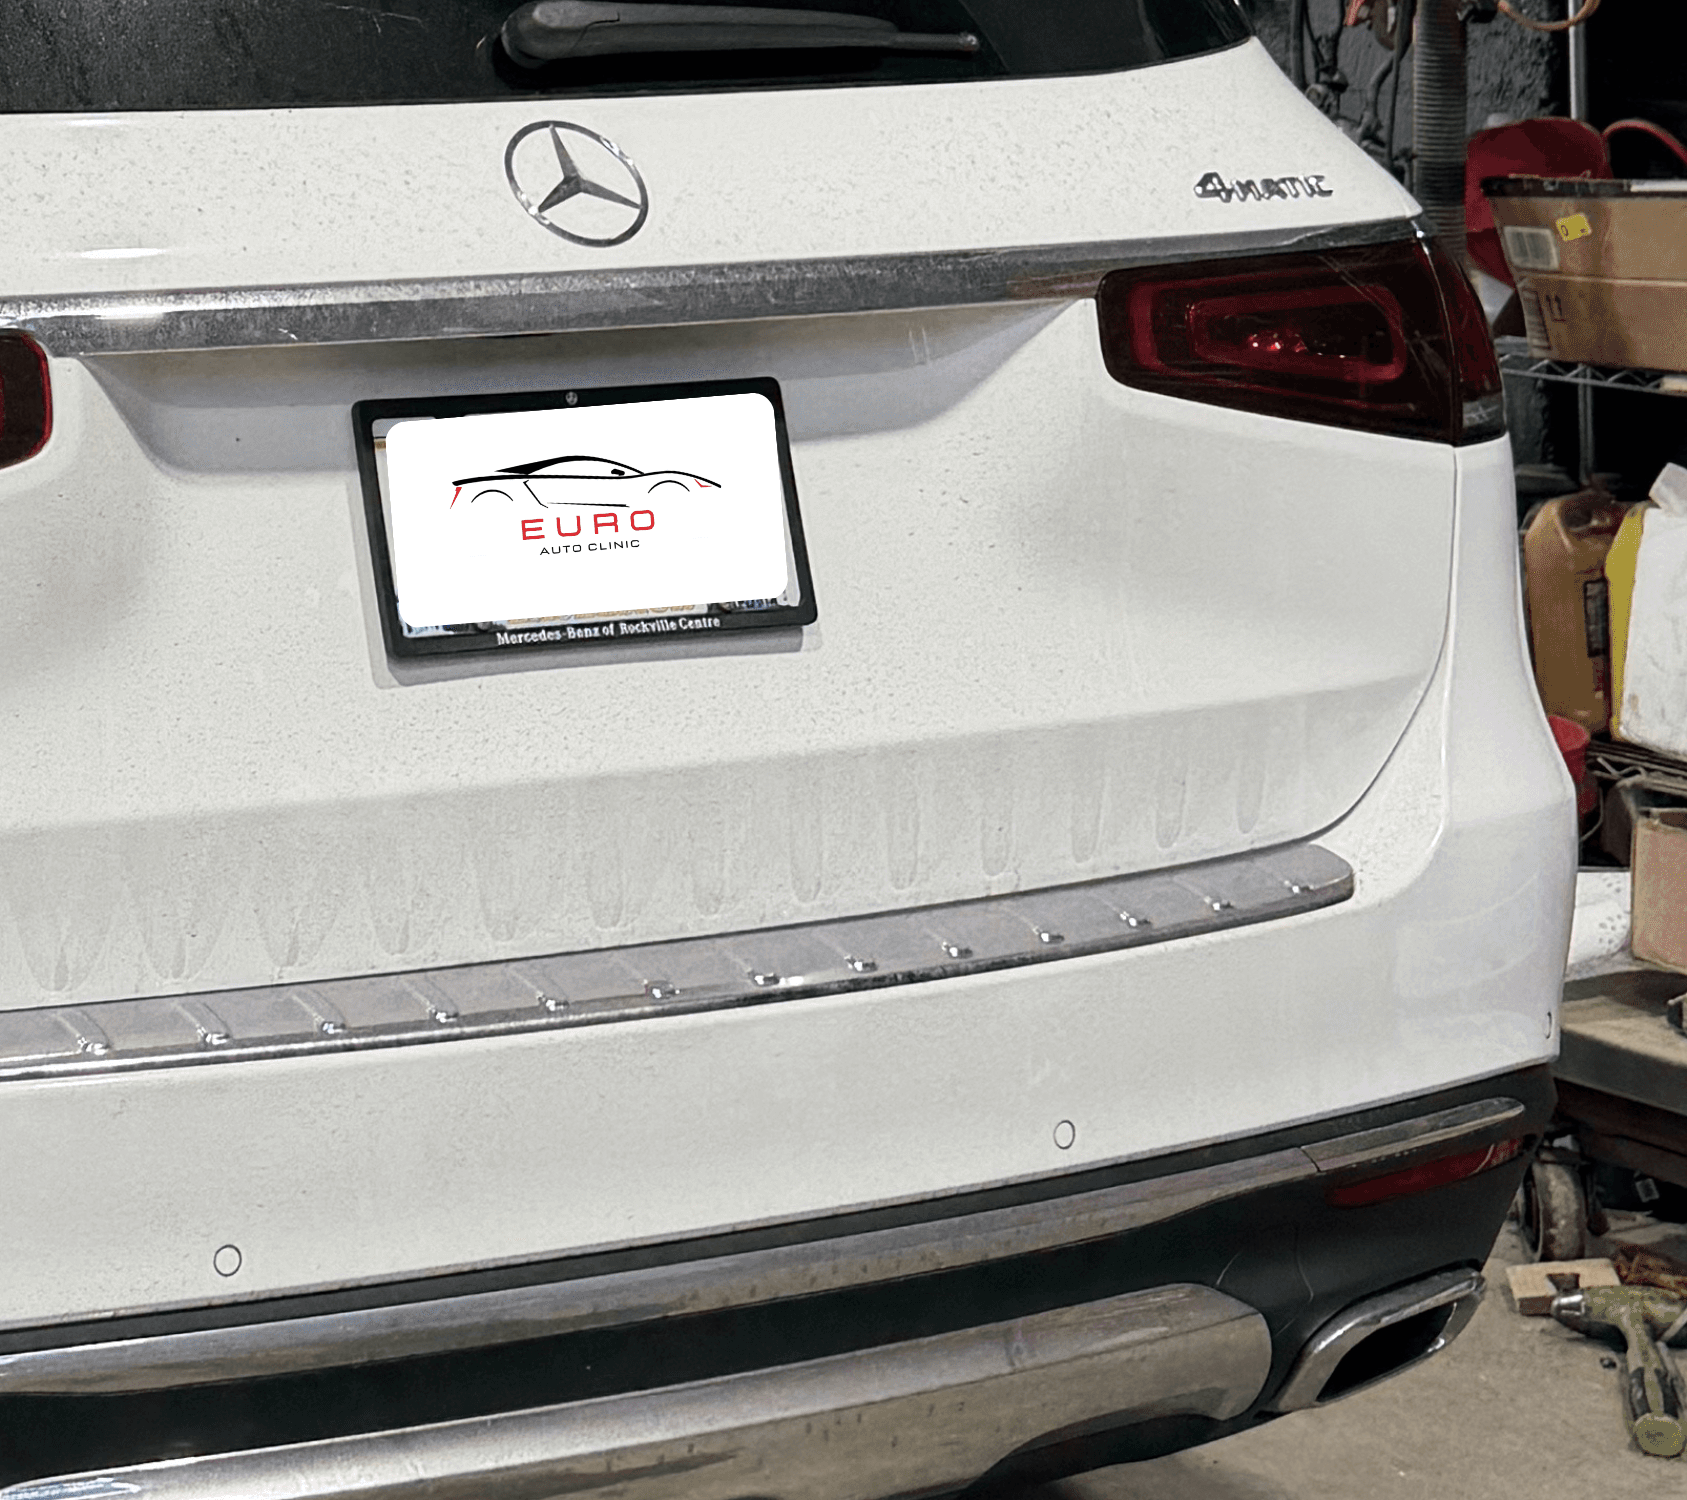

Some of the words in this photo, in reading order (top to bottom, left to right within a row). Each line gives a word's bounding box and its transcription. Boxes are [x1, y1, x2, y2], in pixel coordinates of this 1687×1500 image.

[496, 625, 600, 646] Mercedes-Benz
[602, 623, 615, 636] of
[619, 618, 677, 635] Rockville
[678, 616, 721, 630] Centre
